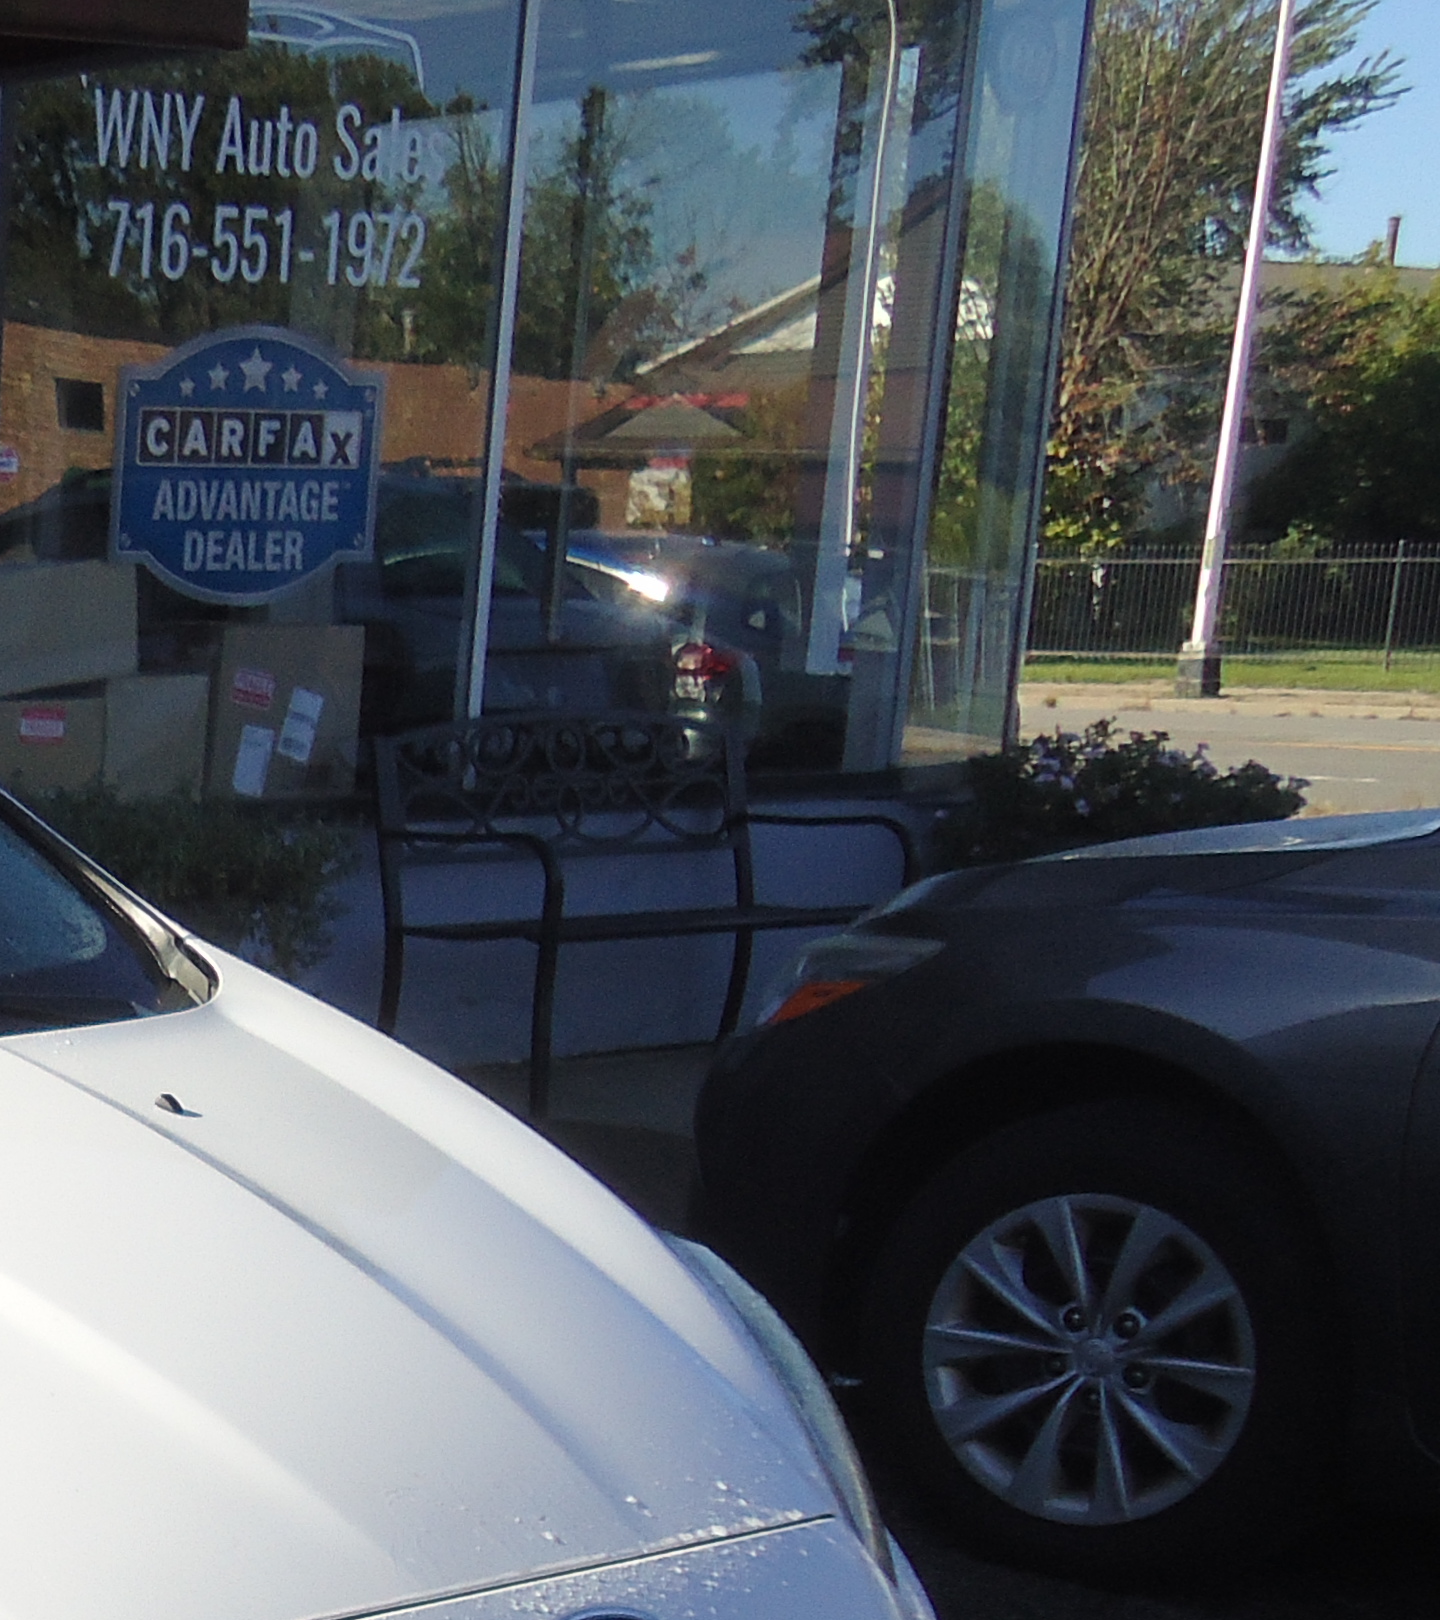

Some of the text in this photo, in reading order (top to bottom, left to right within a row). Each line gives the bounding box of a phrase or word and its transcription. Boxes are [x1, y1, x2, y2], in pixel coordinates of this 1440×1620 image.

[94, 87, 448, 184] WNY Auto Sales
[107, 199, 427, 289] 716-551-1972
[144, 416, 353, 466] CARFAX
[152, 479, 340, 522] ADVANTAGE
[182, 529, 305, 572] DEALER
